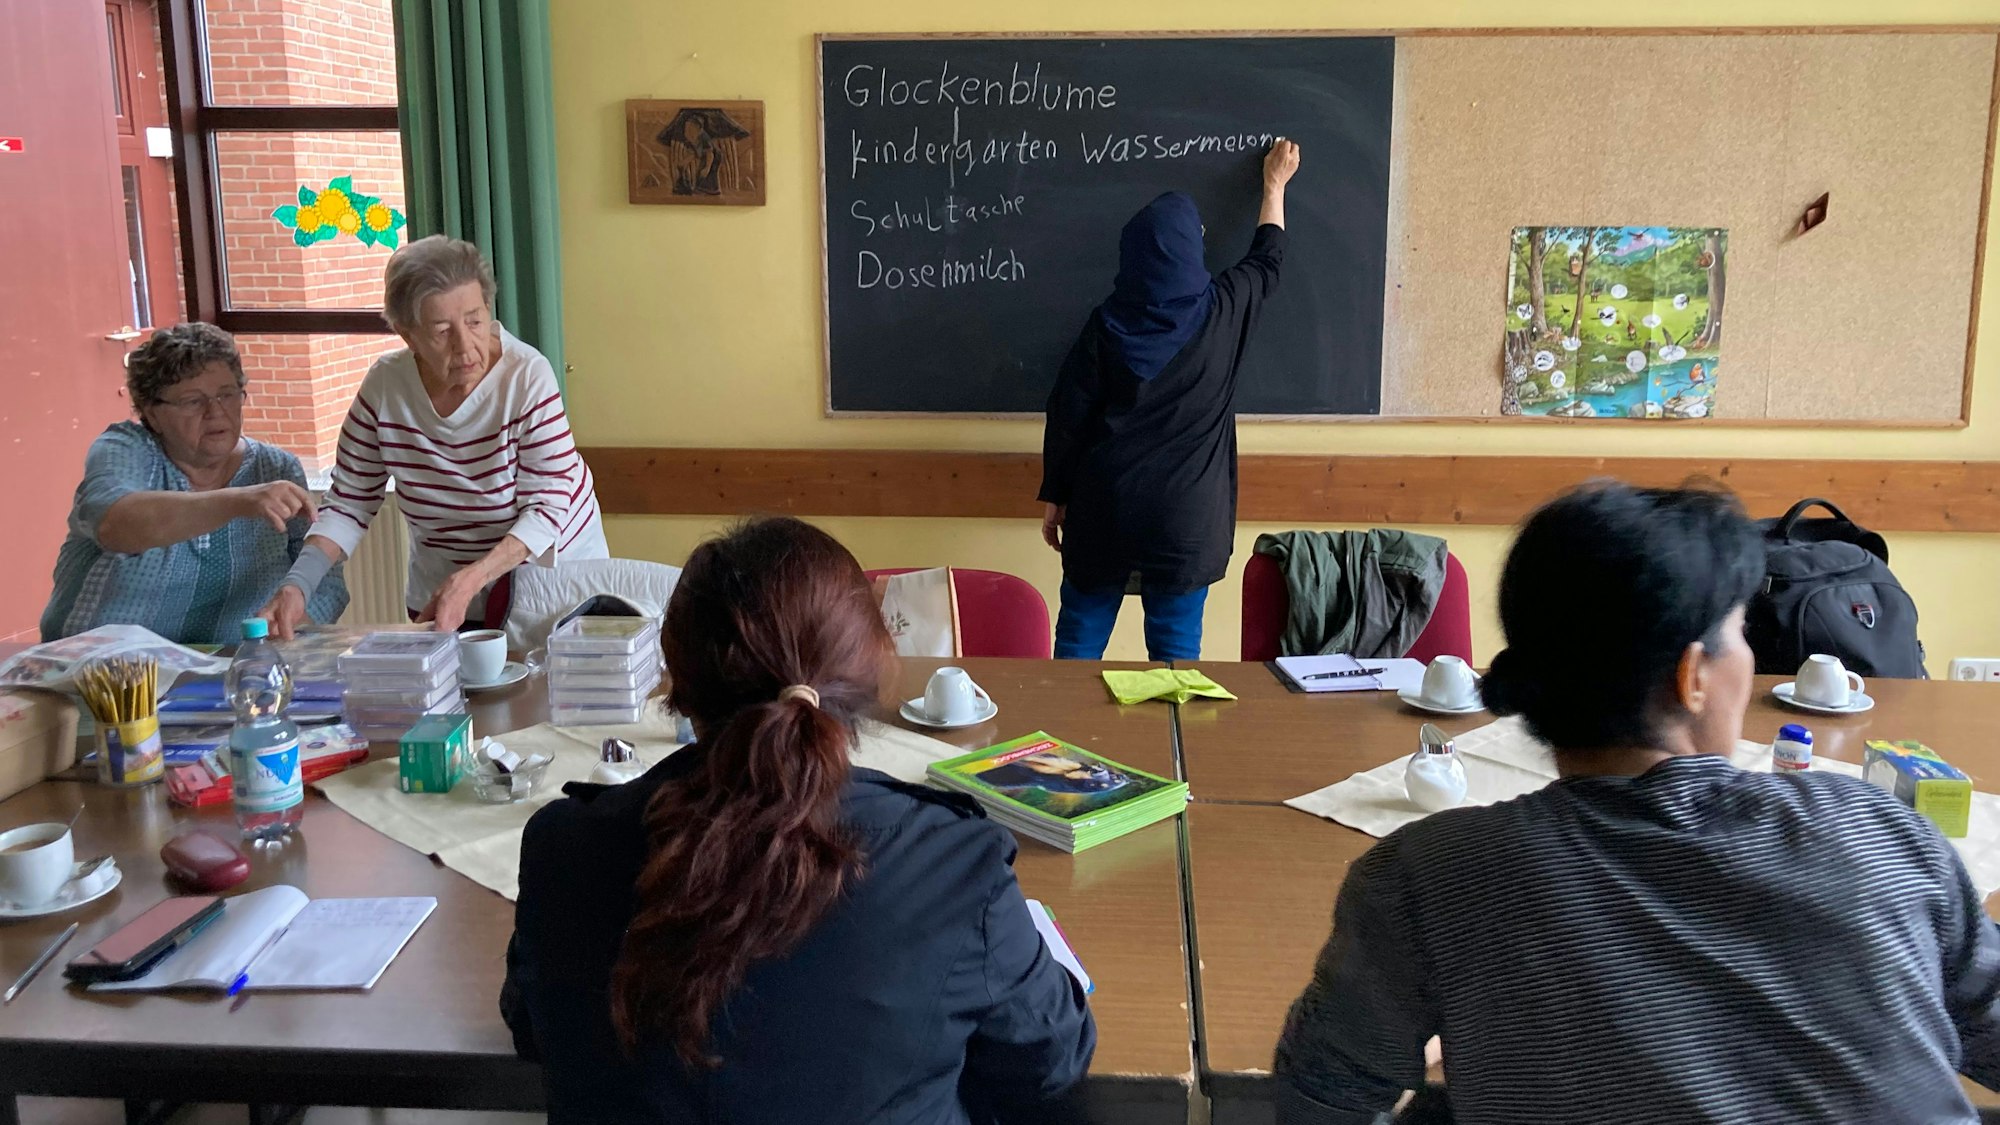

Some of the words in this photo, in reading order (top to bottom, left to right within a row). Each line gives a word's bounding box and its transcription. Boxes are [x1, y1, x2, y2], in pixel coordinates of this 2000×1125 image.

[844, 60, 1116, 111] Glockenblume
[851, 194, 1025, 237] Schultasche
[858, 248, 1026, 289] Dosenmilch
